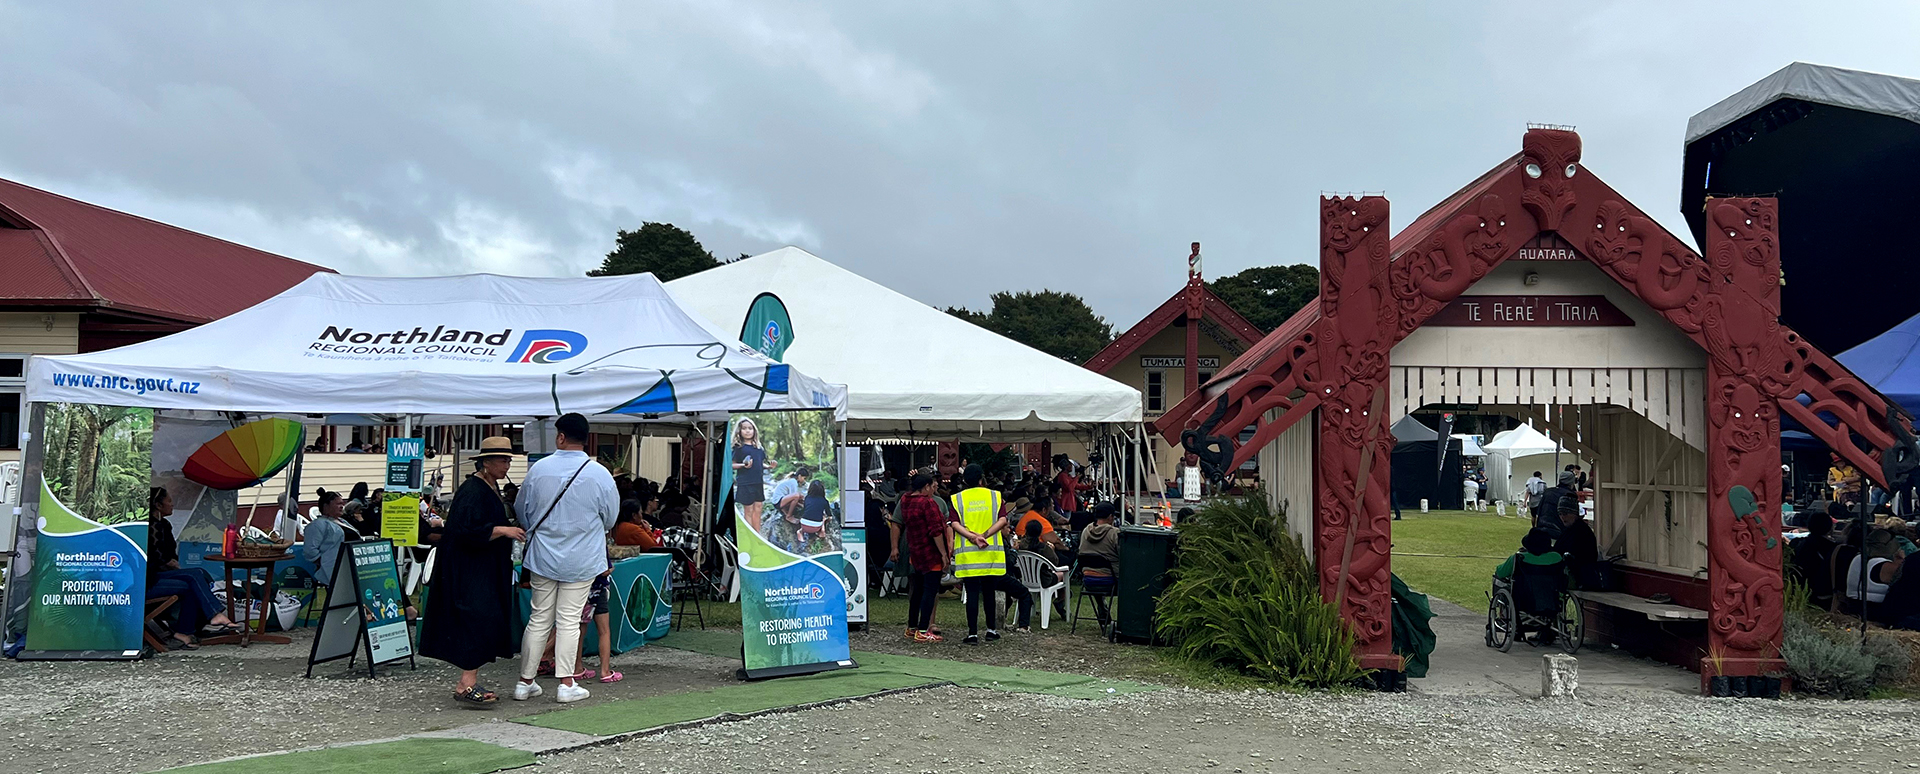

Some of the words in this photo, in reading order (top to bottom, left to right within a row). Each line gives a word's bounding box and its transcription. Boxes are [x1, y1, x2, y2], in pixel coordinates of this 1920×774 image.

[1519, 248, 1576, 260] RUATARA
[1462, 302, 1482, 321] TE
[1554, 302, 1600, 321] TIRIA
[318, 325, 513, 346] Northland
[308, 342, 406, 355] REGIONAL
[412, 344, 498, 357] COUNCIL
[1144, 358, 1217, 367] TUMATANGA
[53, 372, 201, 396] www.nrc.govt.nz
[393, 441, 419, 458] WIN!
[56, 551, 107, 562] Northland
[61, 580, 114, 592] PROTECTING
[764, 584, 809, 597] Northland
[42, 594, 61, 606] OUR
[63, 594, 94, 606] NATIVE
[96, 593, 131, 606] TAONGA
[760, 617, 803, 633] RESTORING
[804, 614, 833, 628] HEALTH
[766, 634, 777, 646] TO
[779, 629, 828, 645] FRESHWATER
